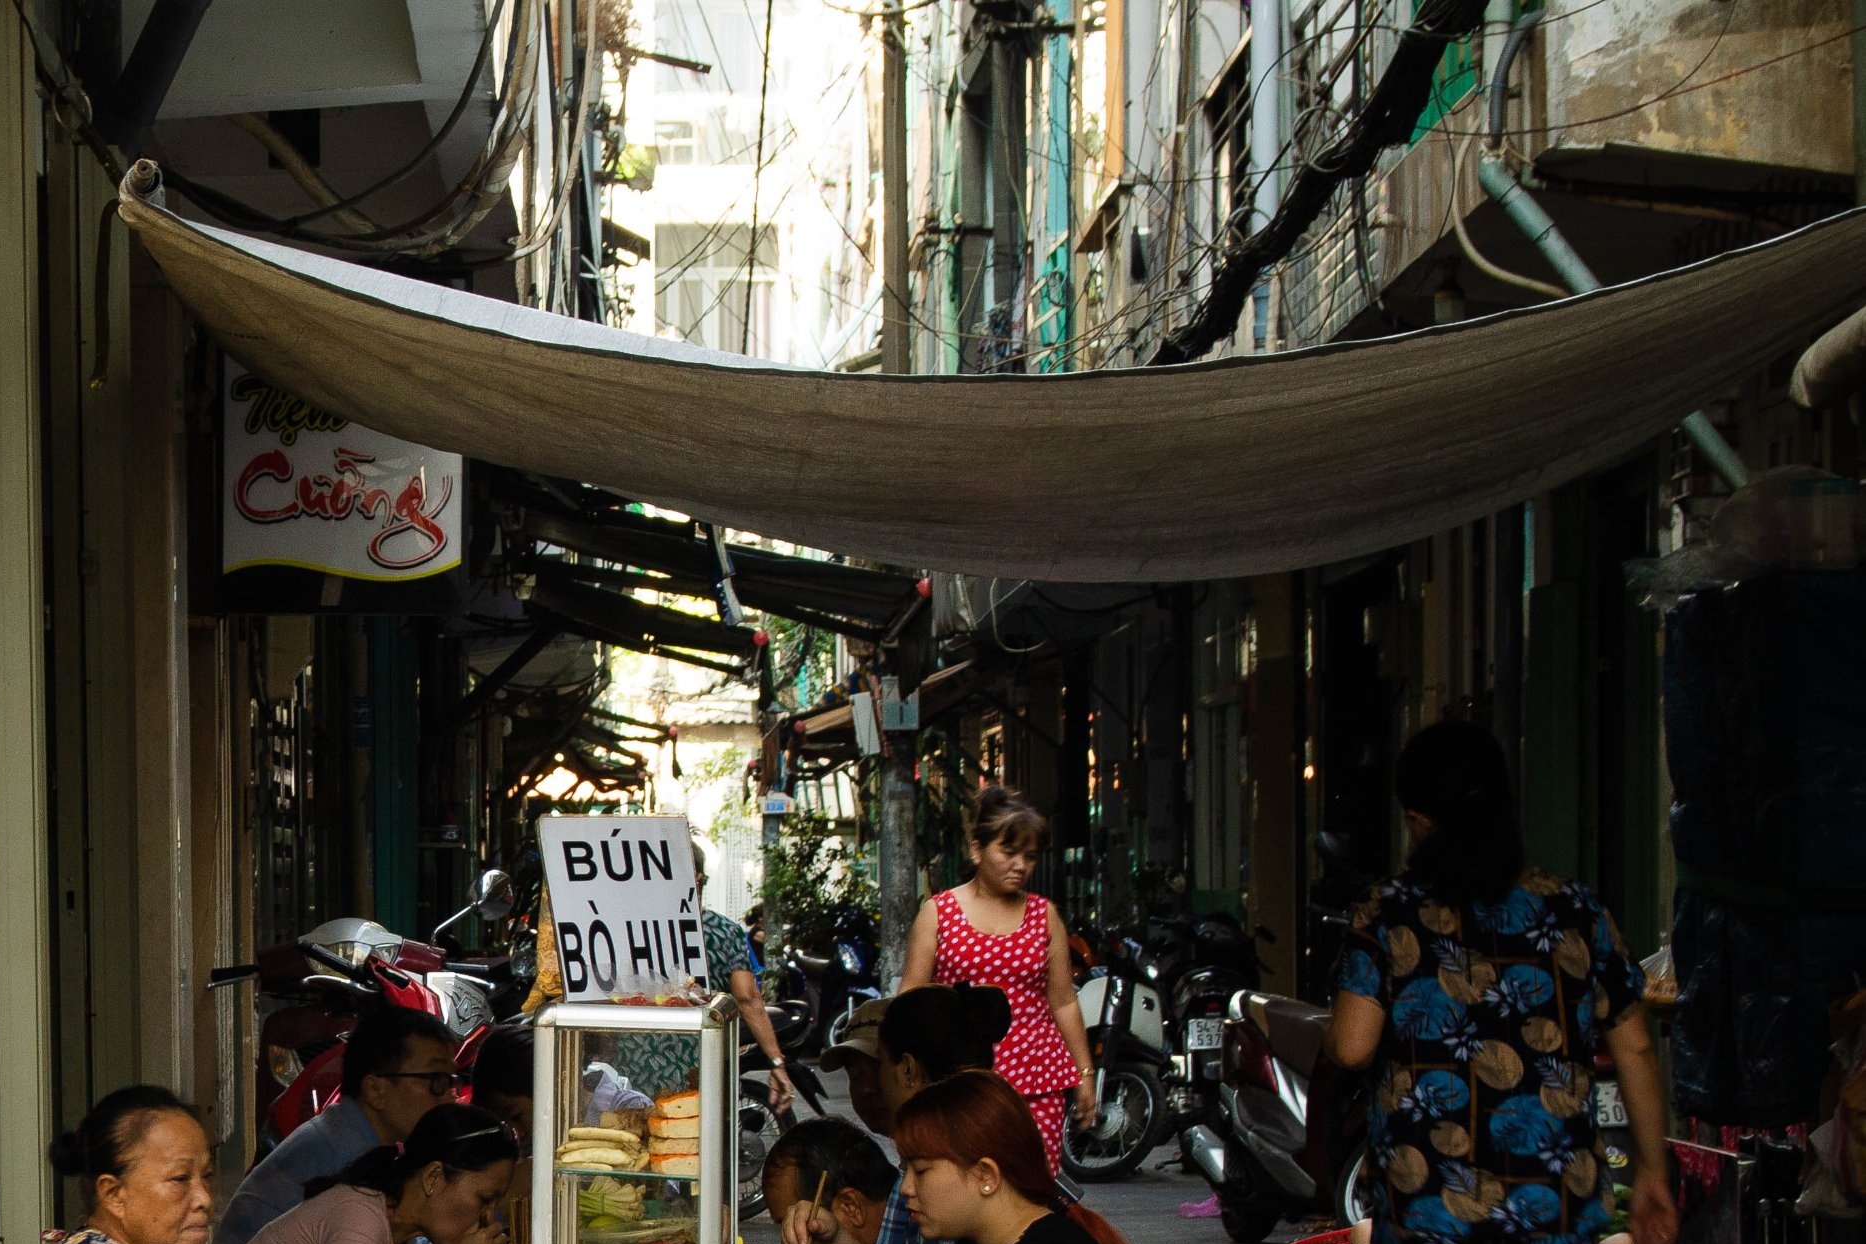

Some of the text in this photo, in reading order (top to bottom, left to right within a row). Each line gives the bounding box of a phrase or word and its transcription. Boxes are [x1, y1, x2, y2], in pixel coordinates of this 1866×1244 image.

[562, 828, 673, 882] BÚN
[558, 887, 707, 993] BÒ HUẾ
